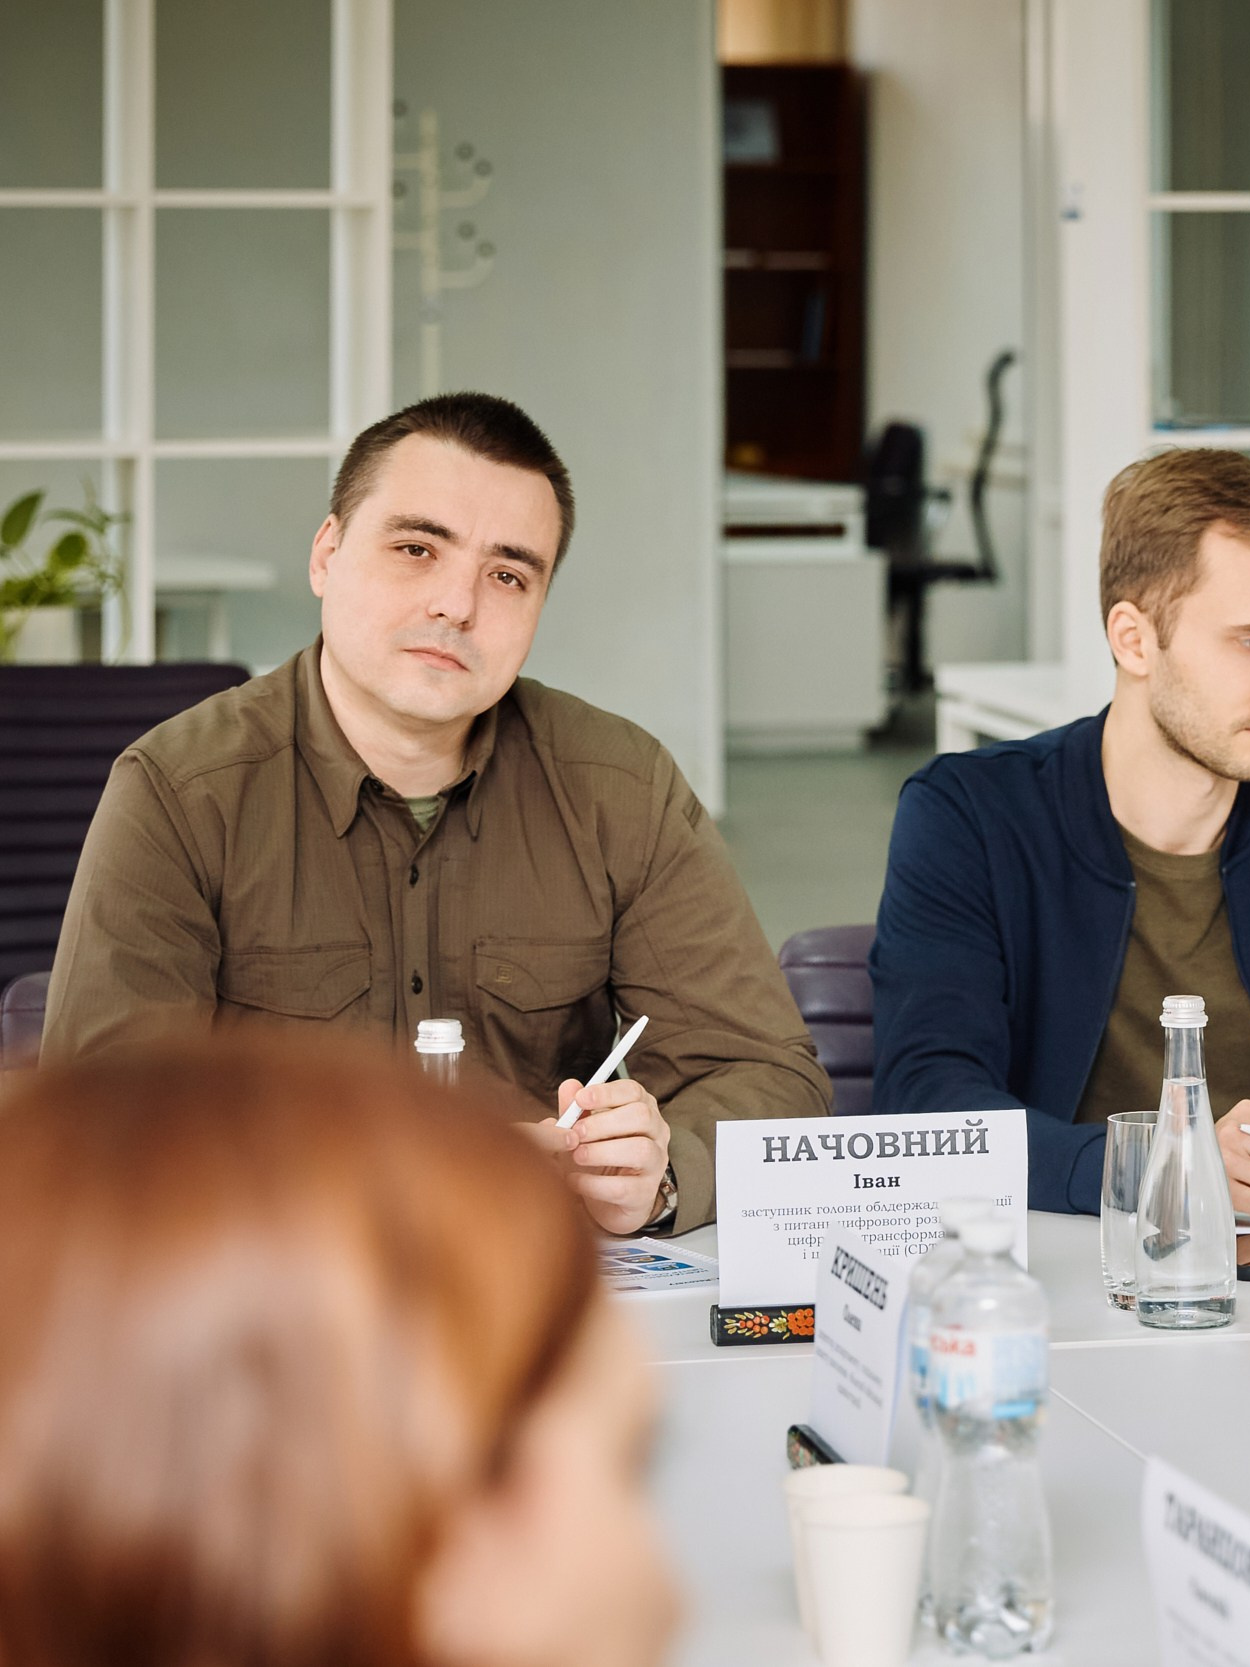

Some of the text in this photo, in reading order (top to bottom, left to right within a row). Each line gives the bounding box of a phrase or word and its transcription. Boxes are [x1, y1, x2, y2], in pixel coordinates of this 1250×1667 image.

[762, 1118, 990, 1163] НАЧОВНИЙ
[853, 1173, 901, 1189] Іван
[741, 1206, 812, 1219] заступник
[816, 1204, 861, 1215] голови
[773, 1223, 780, 1231] з
[861, 1229, 945, 1244] трансформа
